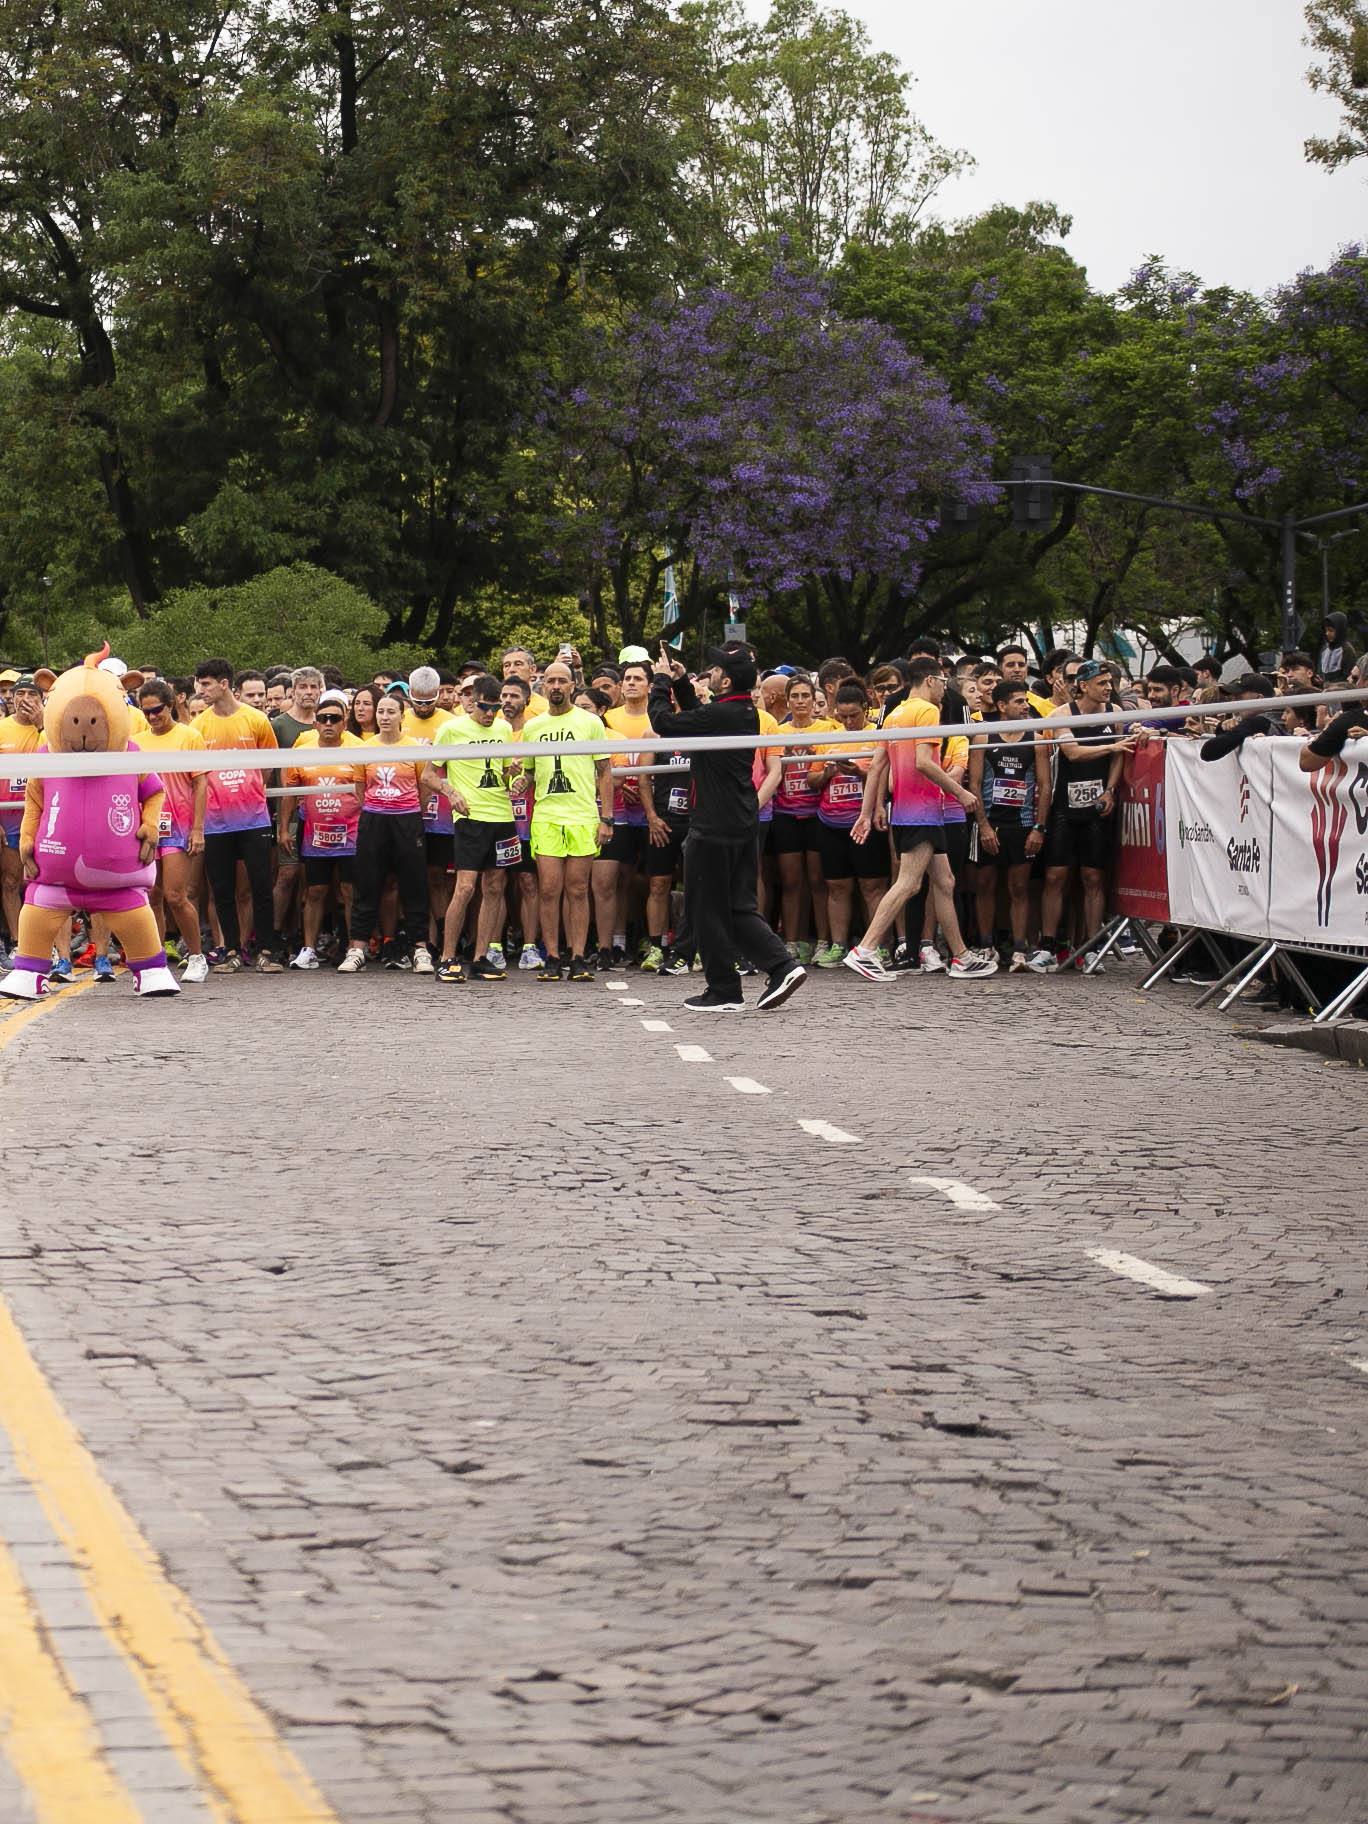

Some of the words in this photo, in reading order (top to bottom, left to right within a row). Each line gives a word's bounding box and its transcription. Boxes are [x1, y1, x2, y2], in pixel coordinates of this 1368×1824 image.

[539, 728, 575, 743] GUÍA
[219, 770, 247, 780] COPA
[789, 781, 809, 791] 571
[833, 783, 859, 795] 5718
[375, 788, 402, 797] COPA
[1003, 788, 1018, 798] 22
[315, 799, 342, 808] COPA
[318, 832, 343, 842] 5805
[503, 846, 520, 858] 625
[1227, 836, 1252, 872] Santa
[1251, 837, 1261, 873] Fe
